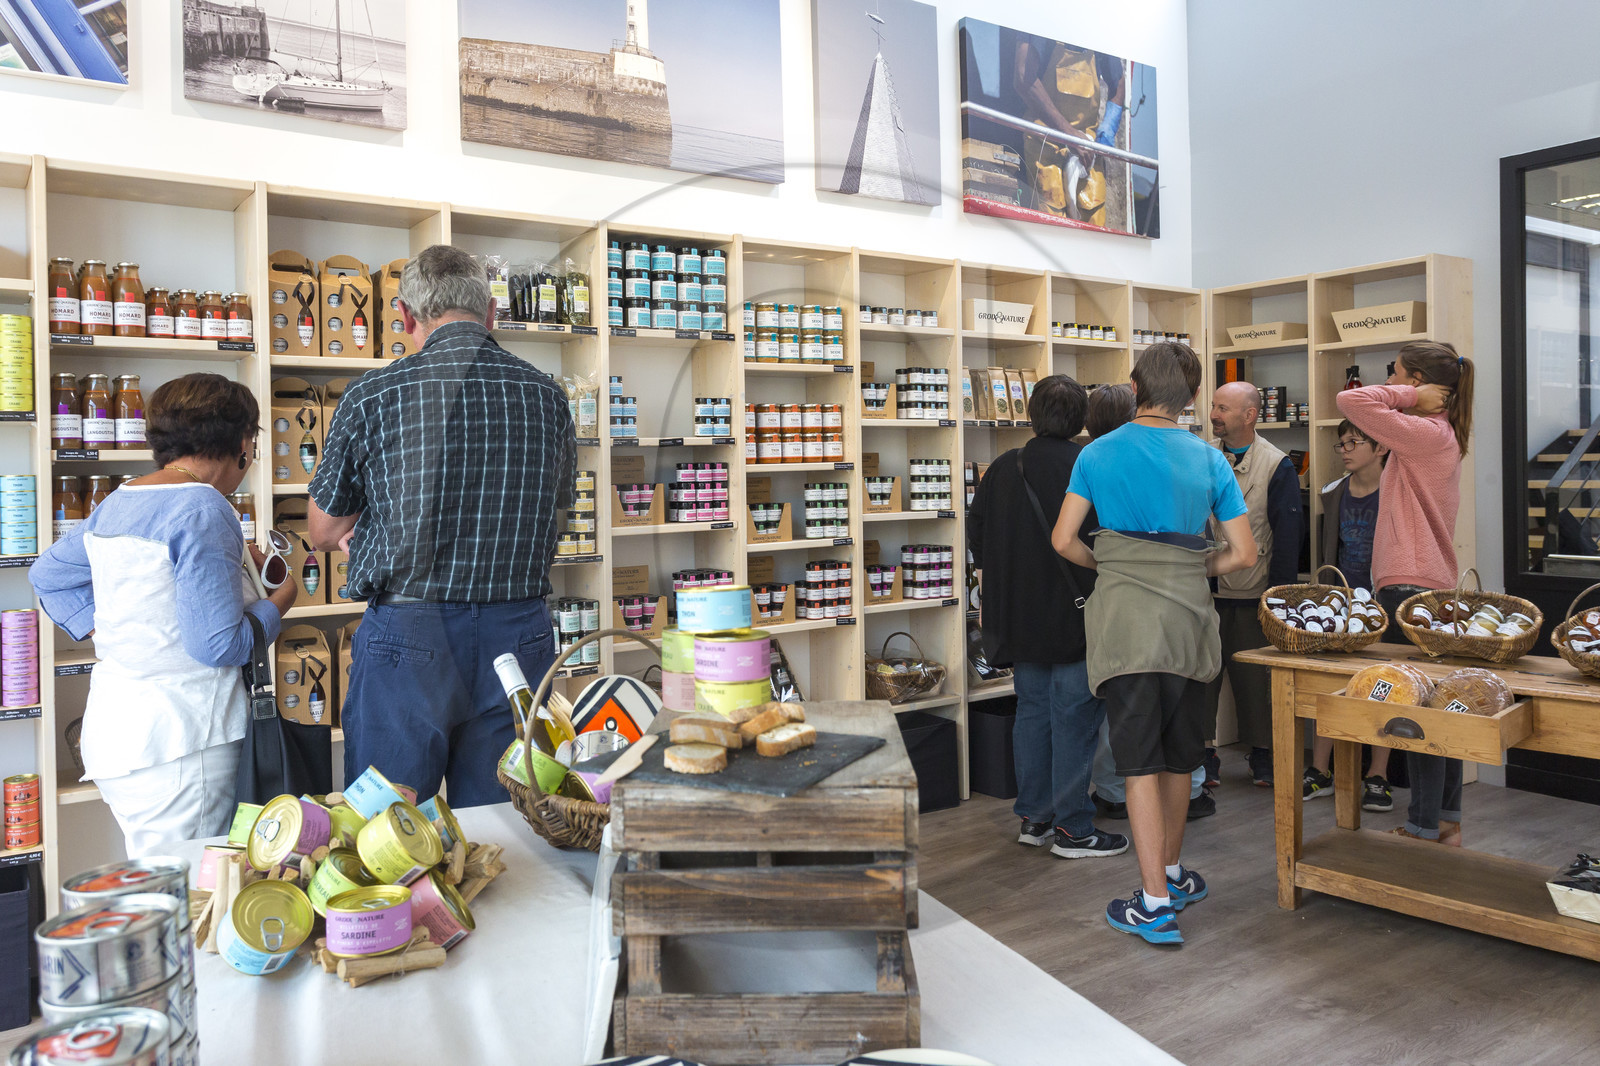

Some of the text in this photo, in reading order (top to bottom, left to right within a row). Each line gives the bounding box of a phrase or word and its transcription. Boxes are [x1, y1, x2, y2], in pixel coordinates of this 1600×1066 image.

[696, 660, 719, 668] SARDINE
[357, 913, 385, 923] NATURE
[341, 930, 377, 940] SARDINE
